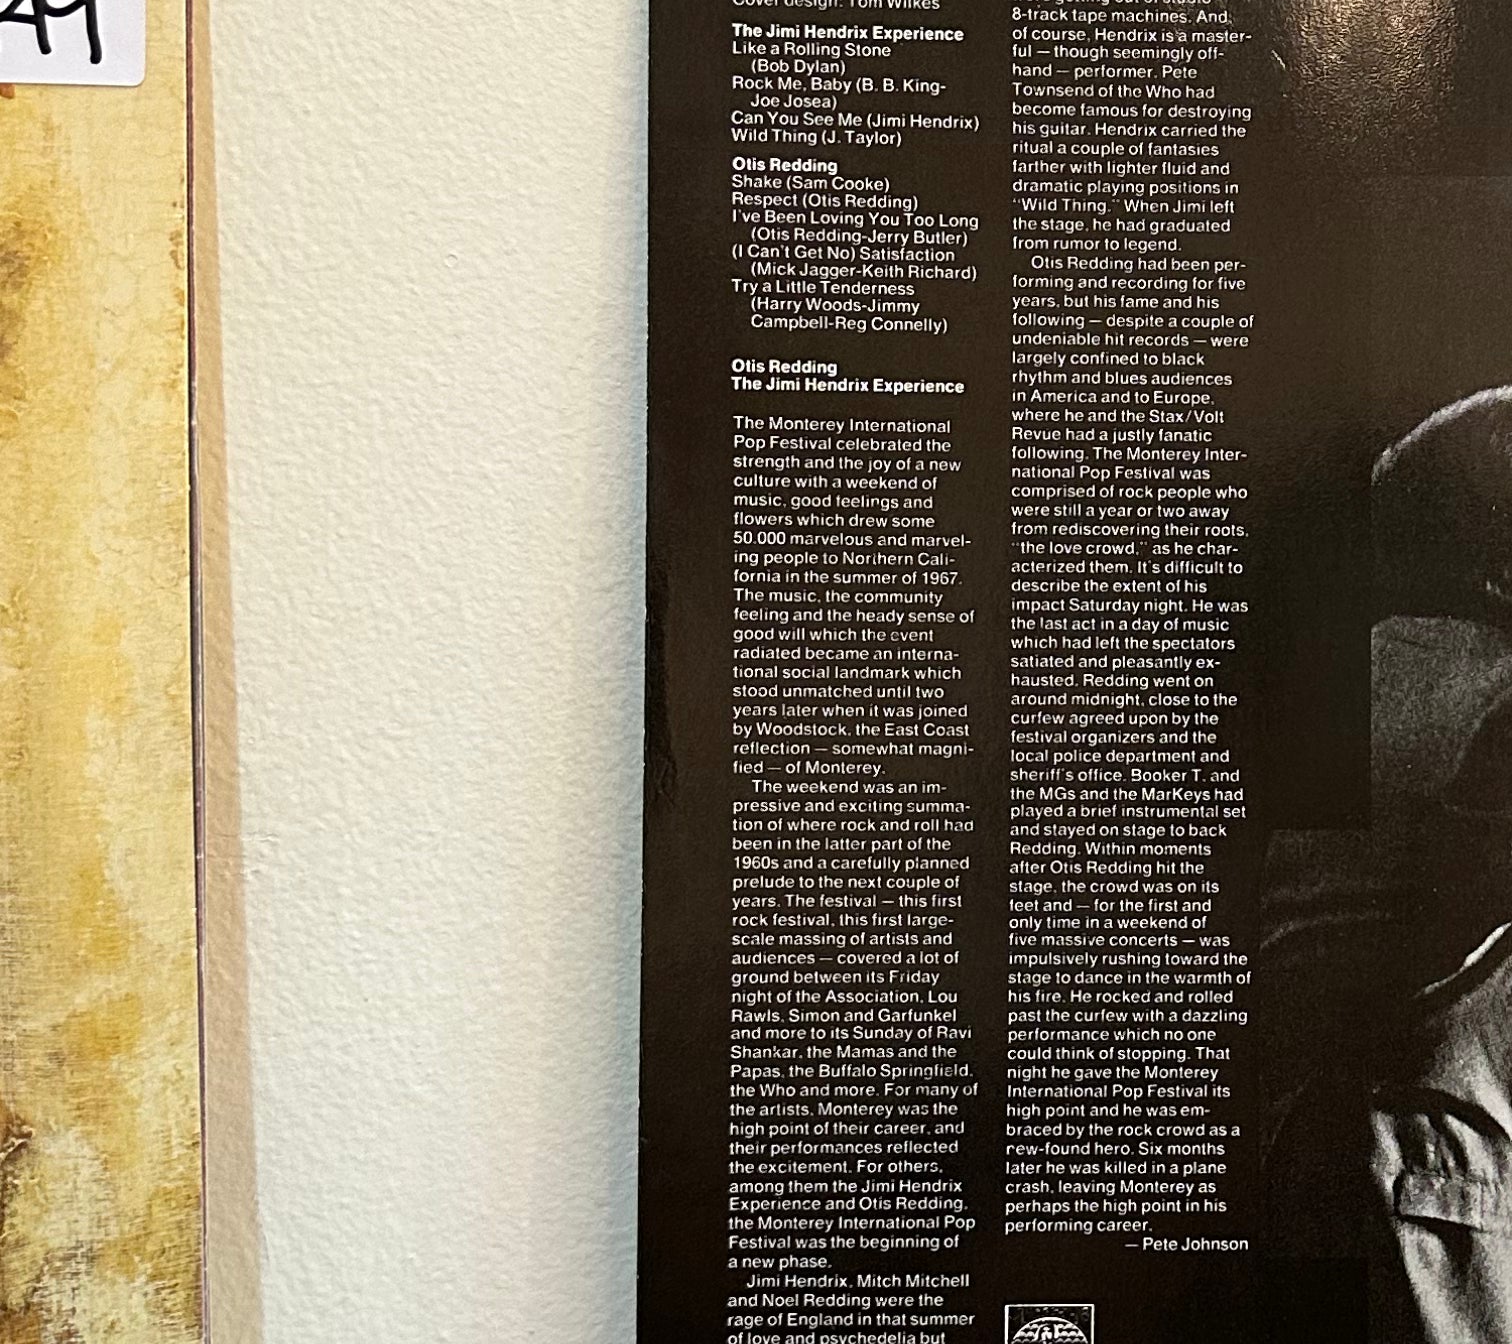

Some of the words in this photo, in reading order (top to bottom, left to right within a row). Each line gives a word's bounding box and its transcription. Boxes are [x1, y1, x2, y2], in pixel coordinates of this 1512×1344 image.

[732, 23, 762, 37] The
[766, 24, 800, 38] Jimi
[804, 24, 868, 39] Hendrix
[872, 25, 964, 43] Experience
[732, 41, 766, 55] Like
[770, 44, 780, 55] a
[784, 42, 840, 59] Rolling
[845, 42, 891, 57] Stone
[751, 58, 789, 74] (Bob
[794, 59, 845, 76] Dylan)
[1012, 101, 1076, 116] become
[1080, 103, 1138, 117] famous
[1142, 104, 1163, 117] for
[1168, 104, 1251, 121] destroying
[732, 156, 766, 171] Otis
[769, 158, 838, 175] Redding
[732, 174, 782, 189] Shake
[786, 175, 827, 191] (Sam
[832, 176, 889, 193] Cooke)
[732, 191, 798, 209] Respect
[802, 193, 841, 209] (Otis
[845, 194, 918, 212] Redding)
[731, 358, 765, 373] Otis
[769, 359, 837, 377] Redding
[731, 376, 762, 390] The
[765, 377, 800, 391] Jimi
[805, 377, 869, 392] Hendrix
[873, 378, 964, 395] Experience
[733, 416, 764, 429] The
[769, 416, 844, 434] Monterey
[850, 418, 950, 433] International
[1012, 426, 1061, 440] Revue
[1066, 428, 1095, 441] had
[1099, 431, 1109, 442] a
[1112, 428, 1155, 445] justly
[1159, 428, 1212, 442] fanatic
[734, 512, 793, 525] flowers
[797, 513, 844, 527] which
[848, 514, 888, 527] drew
[892, 517, 935, 528] some
[1085, 842, 1135, 855] Within
[1140, 843, 1211, 856] moments
[789, 1008, 840, 1022] Simon
[844, 1009, 874, 1022] and
[878, 1008, 956, 1022] Garfunkel
[1008, 1027, 1109, 1043] performance
[1113, 1028, 1160, 1041] which
[1164, 1030, 1184, 1041] no
[1187, 1030, 1216, 1041] one
[729, 1141, 767, 1155] their
[770, 1140, 882, 1157] performances
[887, 1140, 958, 1154] reflected
[1143, 1237, 1178, 1251] Pete
[1181, 1237, 1248, 1251] Johnson
